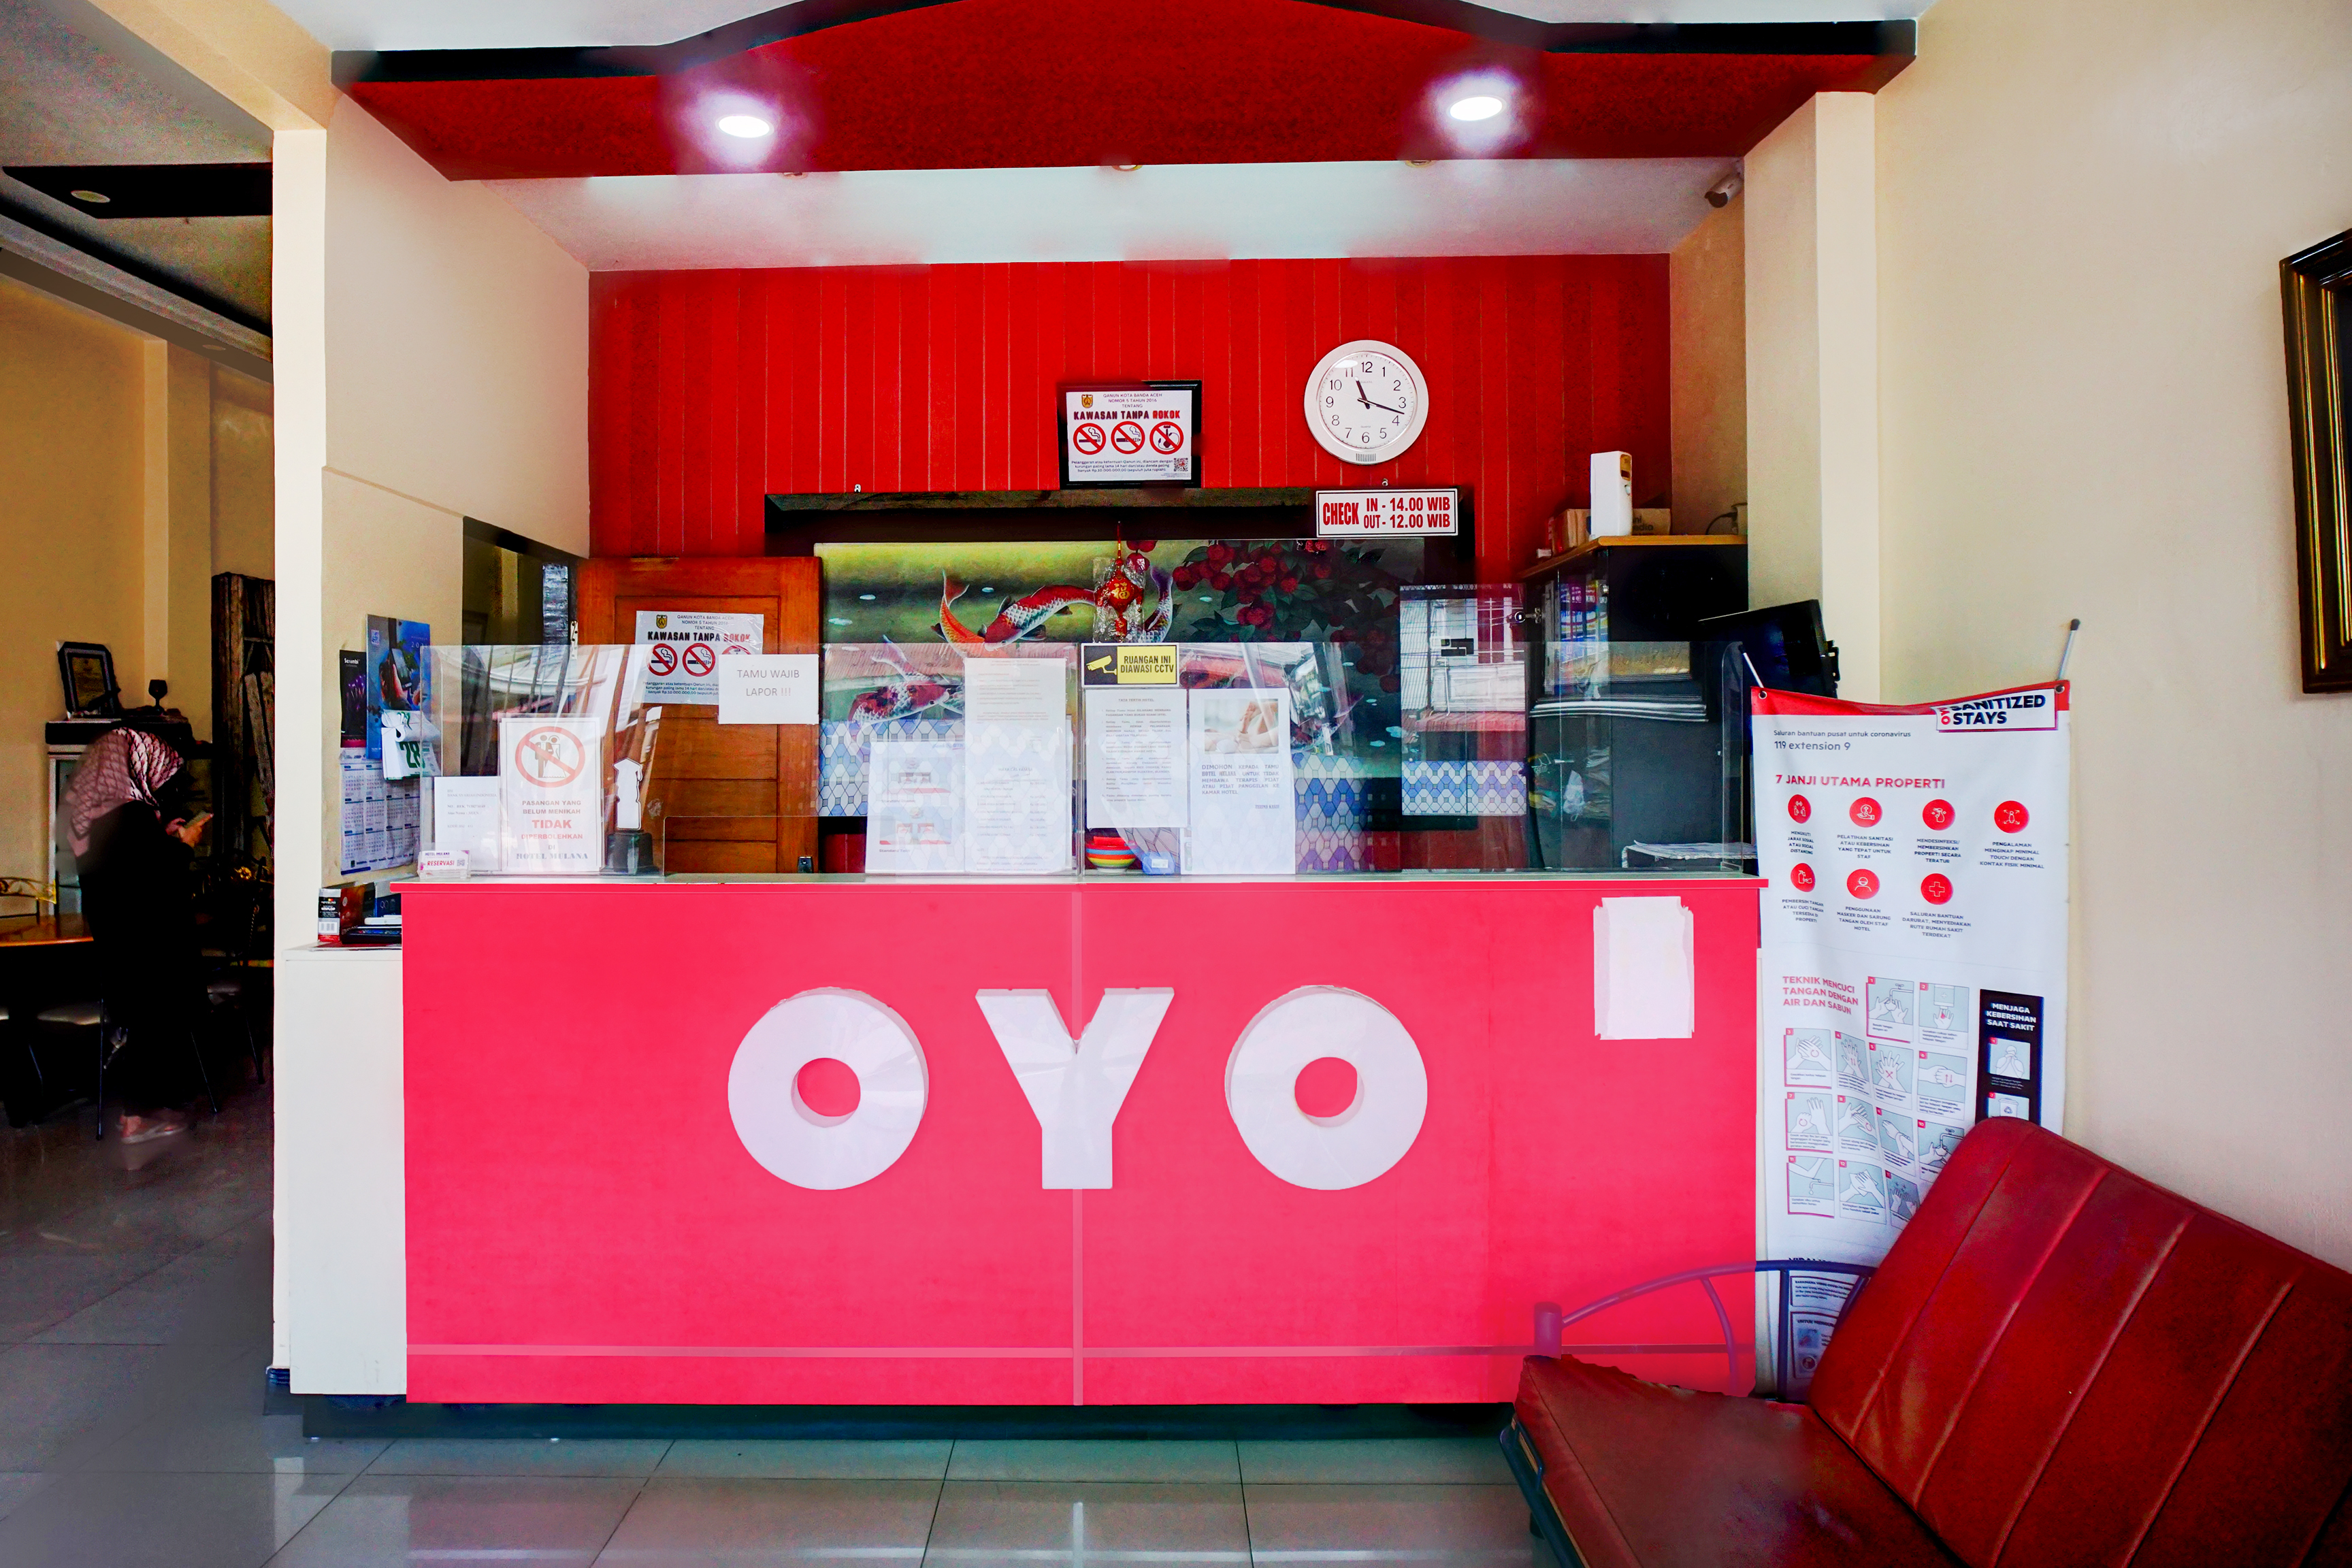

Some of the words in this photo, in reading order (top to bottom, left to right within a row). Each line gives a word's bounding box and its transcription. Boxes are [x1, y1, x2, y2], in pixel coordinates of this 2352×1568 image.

[1345, 367, 1354, 377] 11
[1361, 361, 1373, 373] 12
[1382, 366, 1386, 377] 1
[1329, 379, 1342, 391] 10
[1393, 380, 1401, 391] 2
[1326, 396, 1334, 408] 9
[1399, 397, 1407, 408] 3
[1073, 411, 1117, 420] KAWASAN
[1120, 410, 1149, 419] TANPA
[1152, 410, 1181, 419] ROKOK
[1331, 414, 1340, 426] 8
[1392, 415, 1400, 426] 4
[1345, 427, 1352, 438] 7
[1362, 432, 1370, 444] 6
[1379, 427, 1387, 439] 5
[1366, 498, 1378, 512] IN
[1390, 497, 1423, 511] 14.00
[1427, 497, 1450, 510] WIB
[1322, 502, 1359, 525] CHECK
[1364, 514, 1381, 529] OUT
[1390, 514, 1423, 528] 12.00
[1427, 514, 1450, 527] WIB
[647, 631, 690, 641] KAWASAN
[693, 632, 720, 642] TANPA
[1124, 655, 1158, 664] RUANGAN
[1161, 655, 1171, 664] INI
[737, 670, 767, 679] TAMU
[770, 670, 800, 679] WAJIB
[1120, 664, 1152, 673] DIAWASI
[1154, 664, 1174, 673] CCTV
[746, 688, 777, 696] LAPOR
[1950, 694, 2046, 711] SANITIZED
[1953, 711, 2007, 725] STAYS
[1774, 741, 1786, 749] 119
[1788, 742, 1841, 750] extension
[1776, 774, 1783, 784] 7
[1786, 775, 1816, 785] JANJI
[1820, 777, 1872, 787] UTAMA
[1876, 778, 1945, 789] PROPERTI
[532, 819, 572, 829] TIDAK
[1782, 976, 1820, 985] TEKNIK
[1823, 978, 1855, 994] MENCUCI
[1782, 987, 1827, 996] TANGAN
[1828, 990, 1859, 1006] DENGAN
[1803, 998, 1826, 1007] DAN
[1827, 1001, 1852, 1015] SABUN
[1991, 1002, 2030, 1014] MENJAGA
[1986, 1011, 2037, 1024] KEBERSIHAN
[1987, 1019, 2008, 1028] SAAT
[2010, 1022, 2035, 1032] SAKIT
[728, 983, 1429, 1191] OYO
